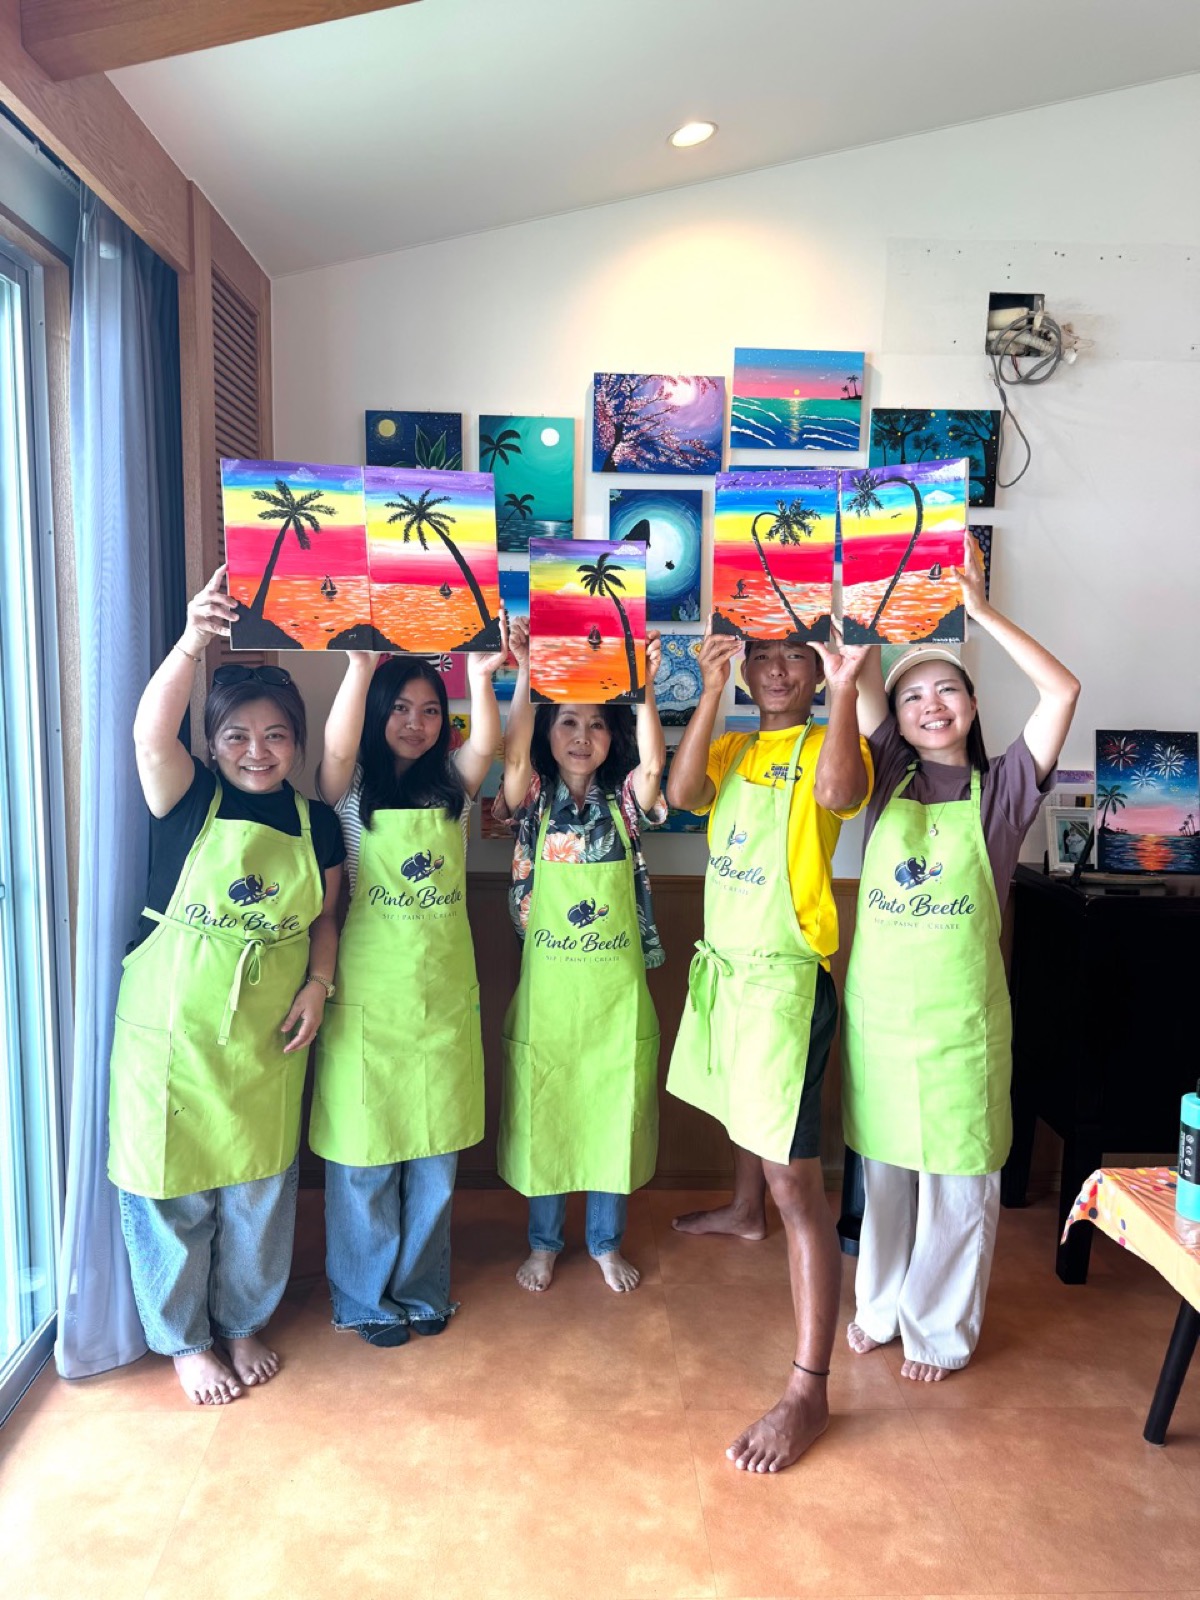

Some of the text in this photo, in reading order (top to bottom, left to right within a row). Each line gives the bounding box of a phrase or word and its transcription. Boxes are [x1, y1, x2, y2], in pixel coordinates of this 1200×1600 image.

[718, 855, 767, 886] Beetle
[368, 884, 415, 908] Pinto
[868, 888, 977, 917] Pinto Beetle
[185, 903, 238, 929] Pinto
[533, 928, 631, 953] Pinto Beetle
